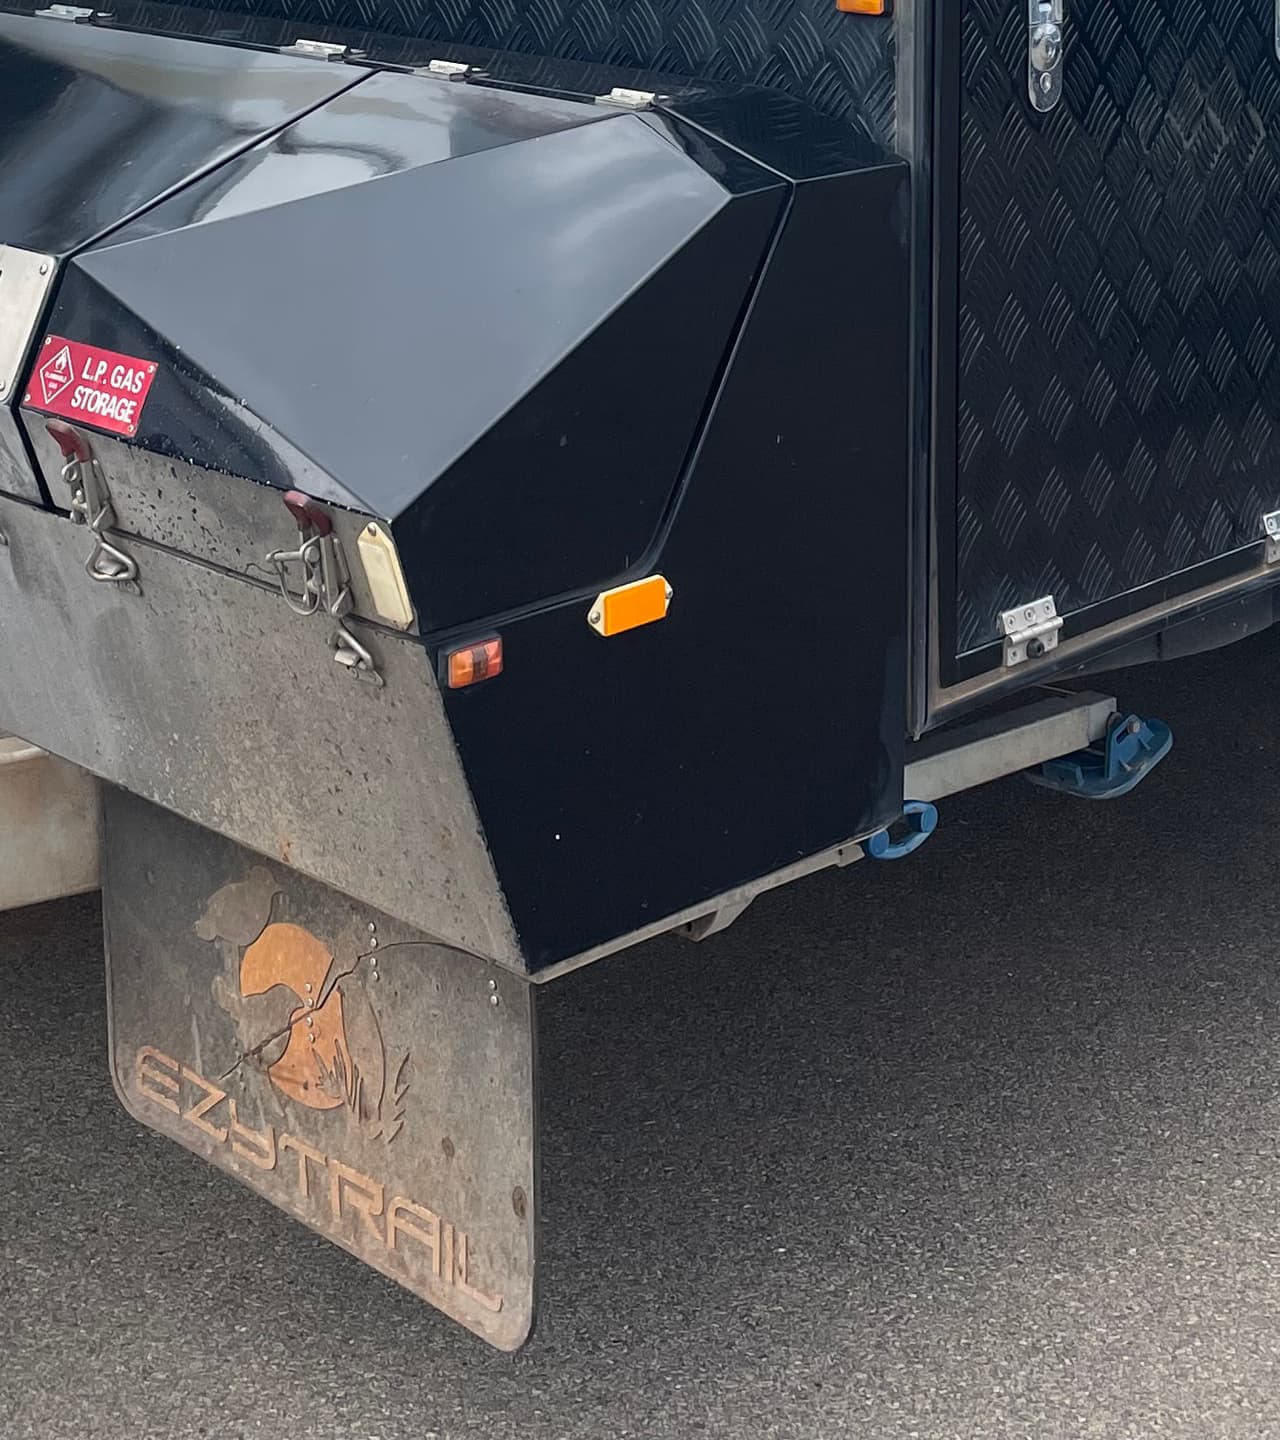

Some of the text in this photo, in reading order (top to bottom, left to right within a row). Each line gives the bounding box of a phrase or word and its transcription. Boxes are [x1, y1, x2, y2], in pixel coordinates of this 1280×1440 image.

[110, 364, 146, 393] GAS
[71, 385, 137, 423] STORAGE
[136, 1045, 503, 1312] EZYTRAIL
